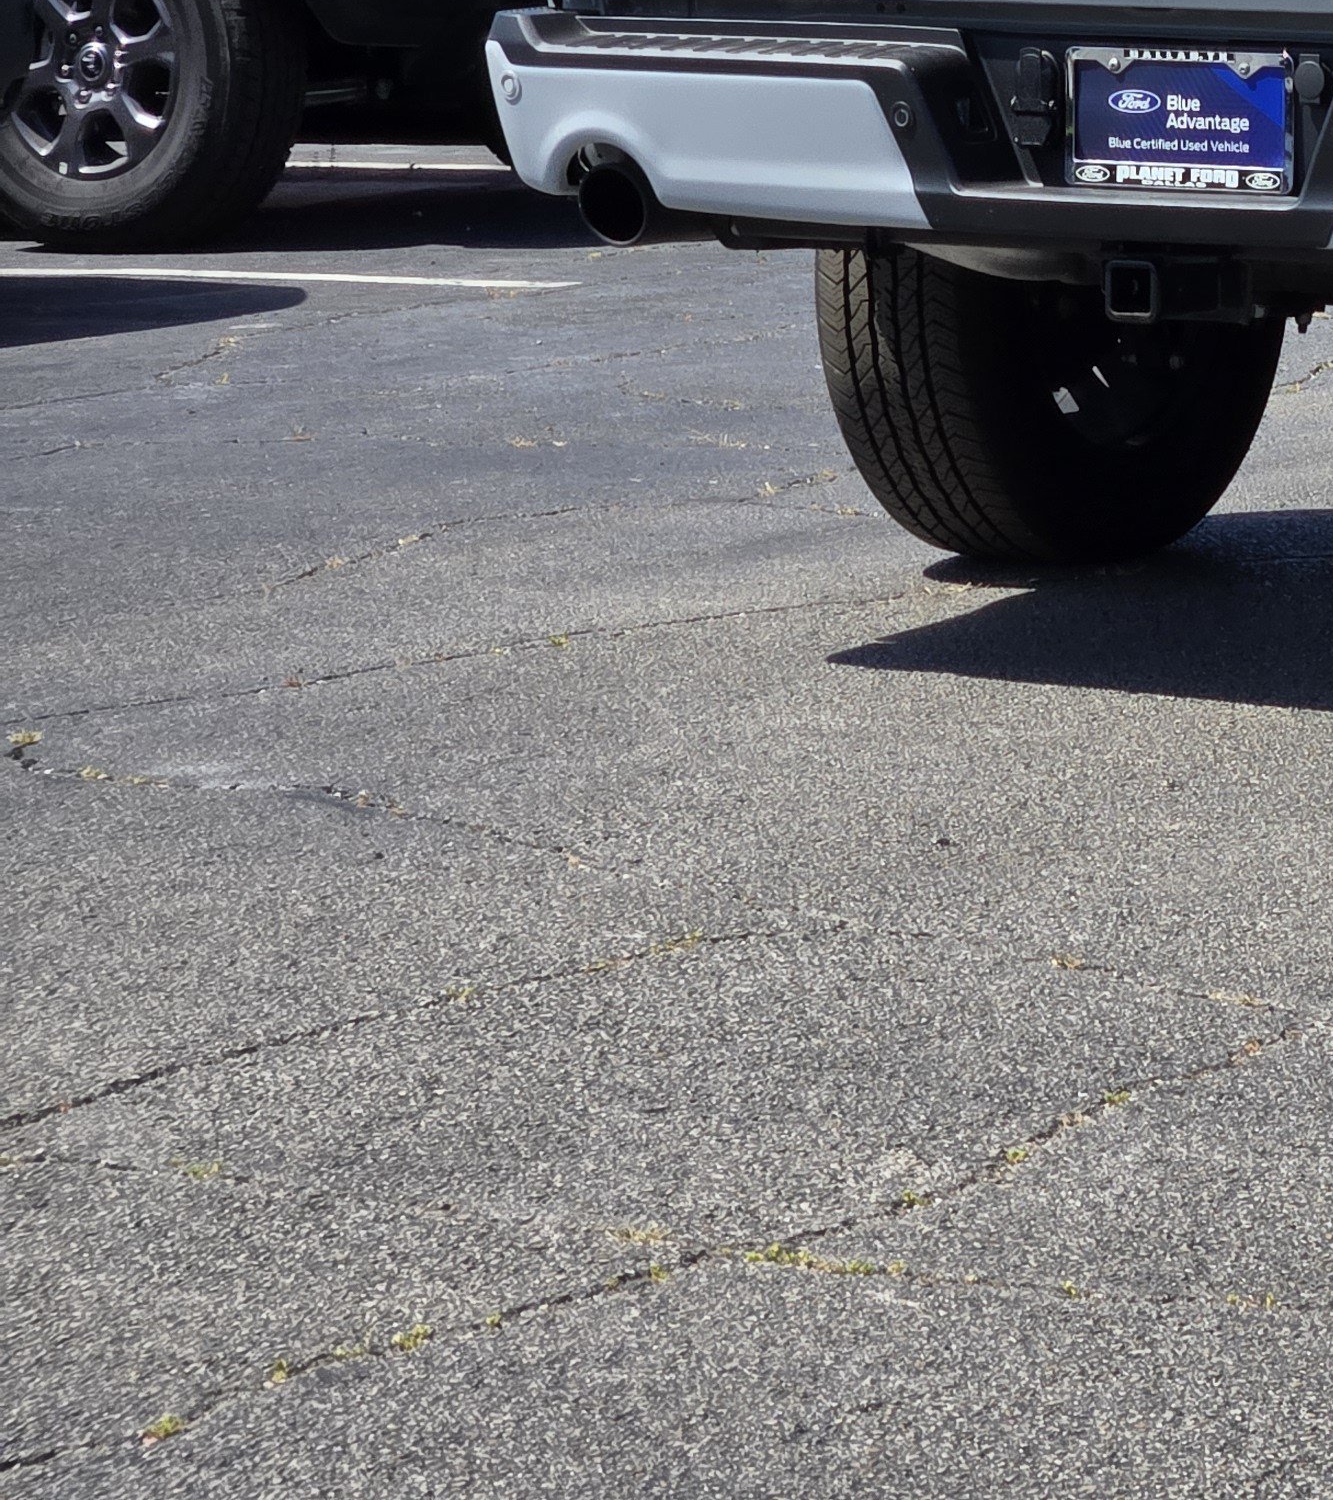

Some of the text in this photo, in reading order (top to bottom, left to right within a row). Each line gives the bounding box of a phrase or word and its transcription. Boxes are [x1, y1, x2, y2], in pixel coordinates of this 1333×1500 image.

[1118, 92, 1151, 110] Ford
[1166, 94, 1201, 112] Blue
[1165, 112, 1250, 134] Advantage
[1108, 136, 1250, 153] Blue Certified Used Vehicle
[1115, 165, 1186, 183] PLANET
